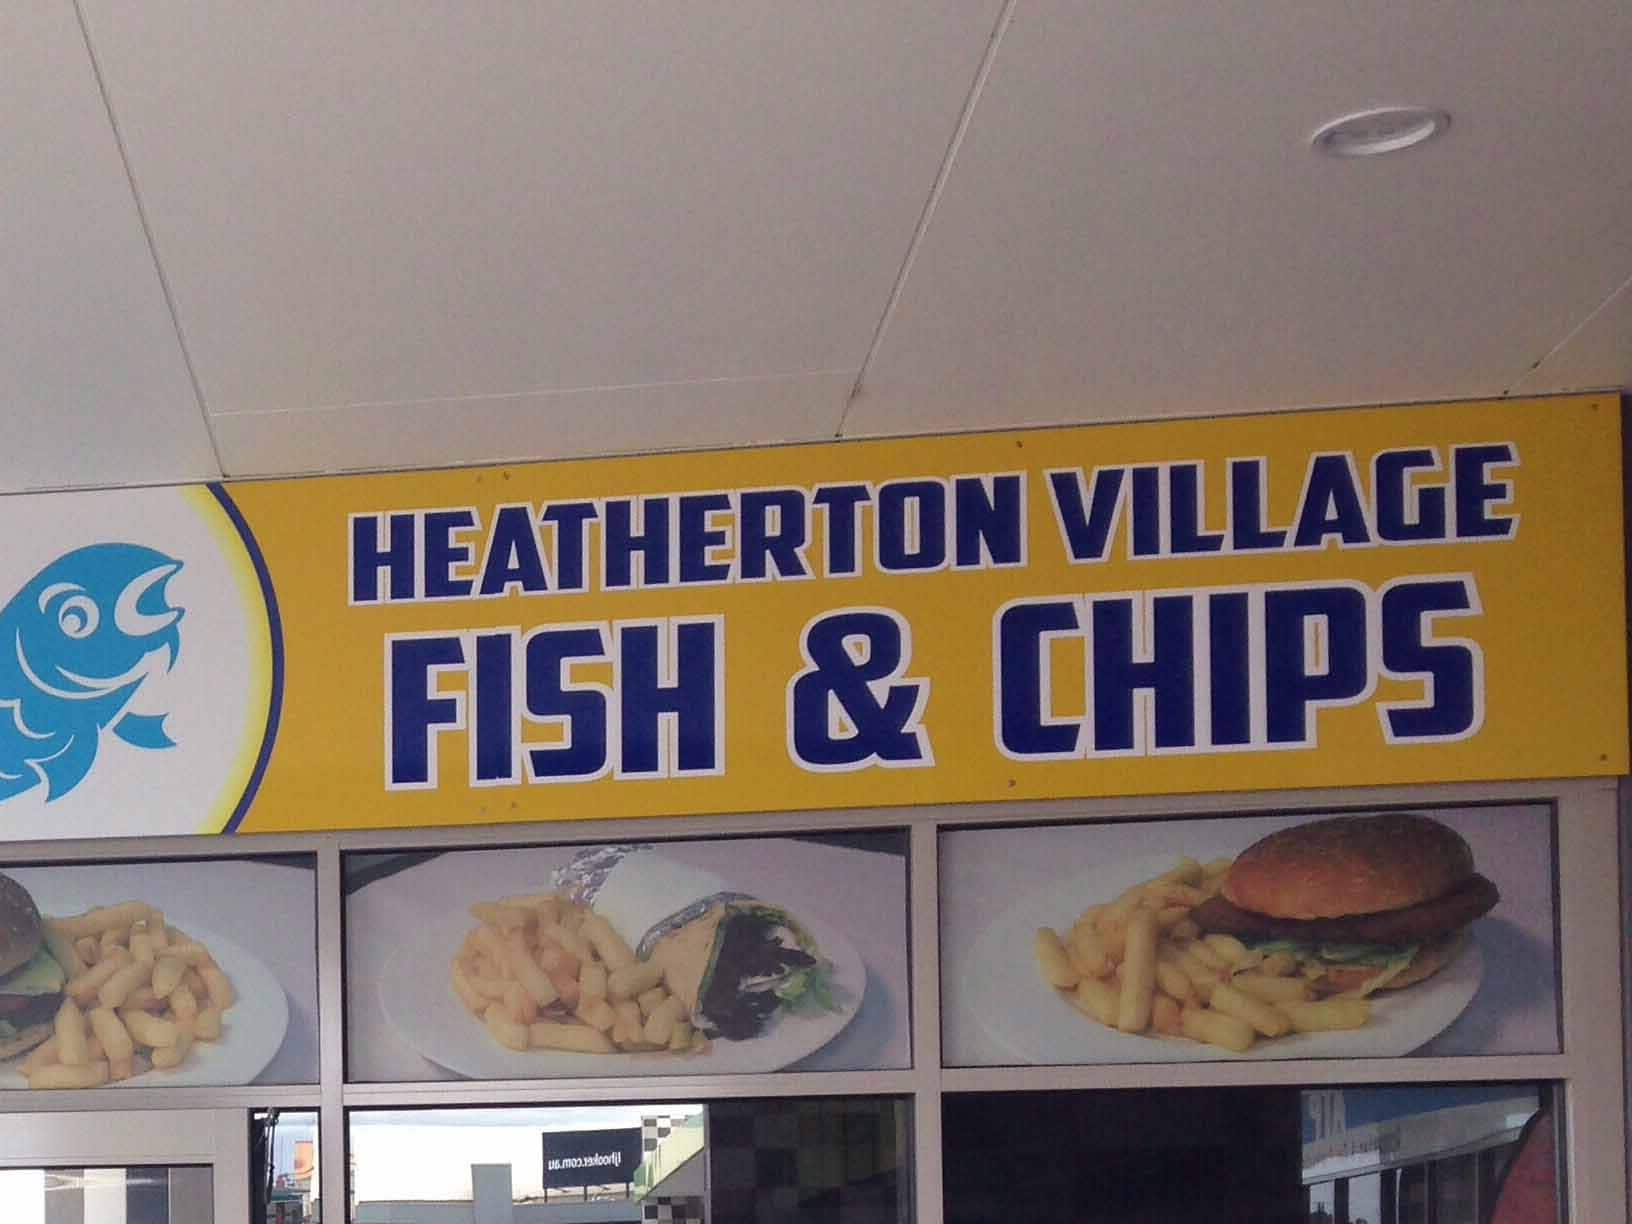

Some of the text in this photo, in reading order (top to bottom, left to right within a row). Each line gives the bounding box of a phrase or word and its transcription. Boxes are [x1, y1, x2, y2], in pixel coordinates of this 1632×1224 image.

[350, 442, 1517, 603] HEATHERTON VILLAGE
[388, 576, 1480, 787] FISH & CHIPS
